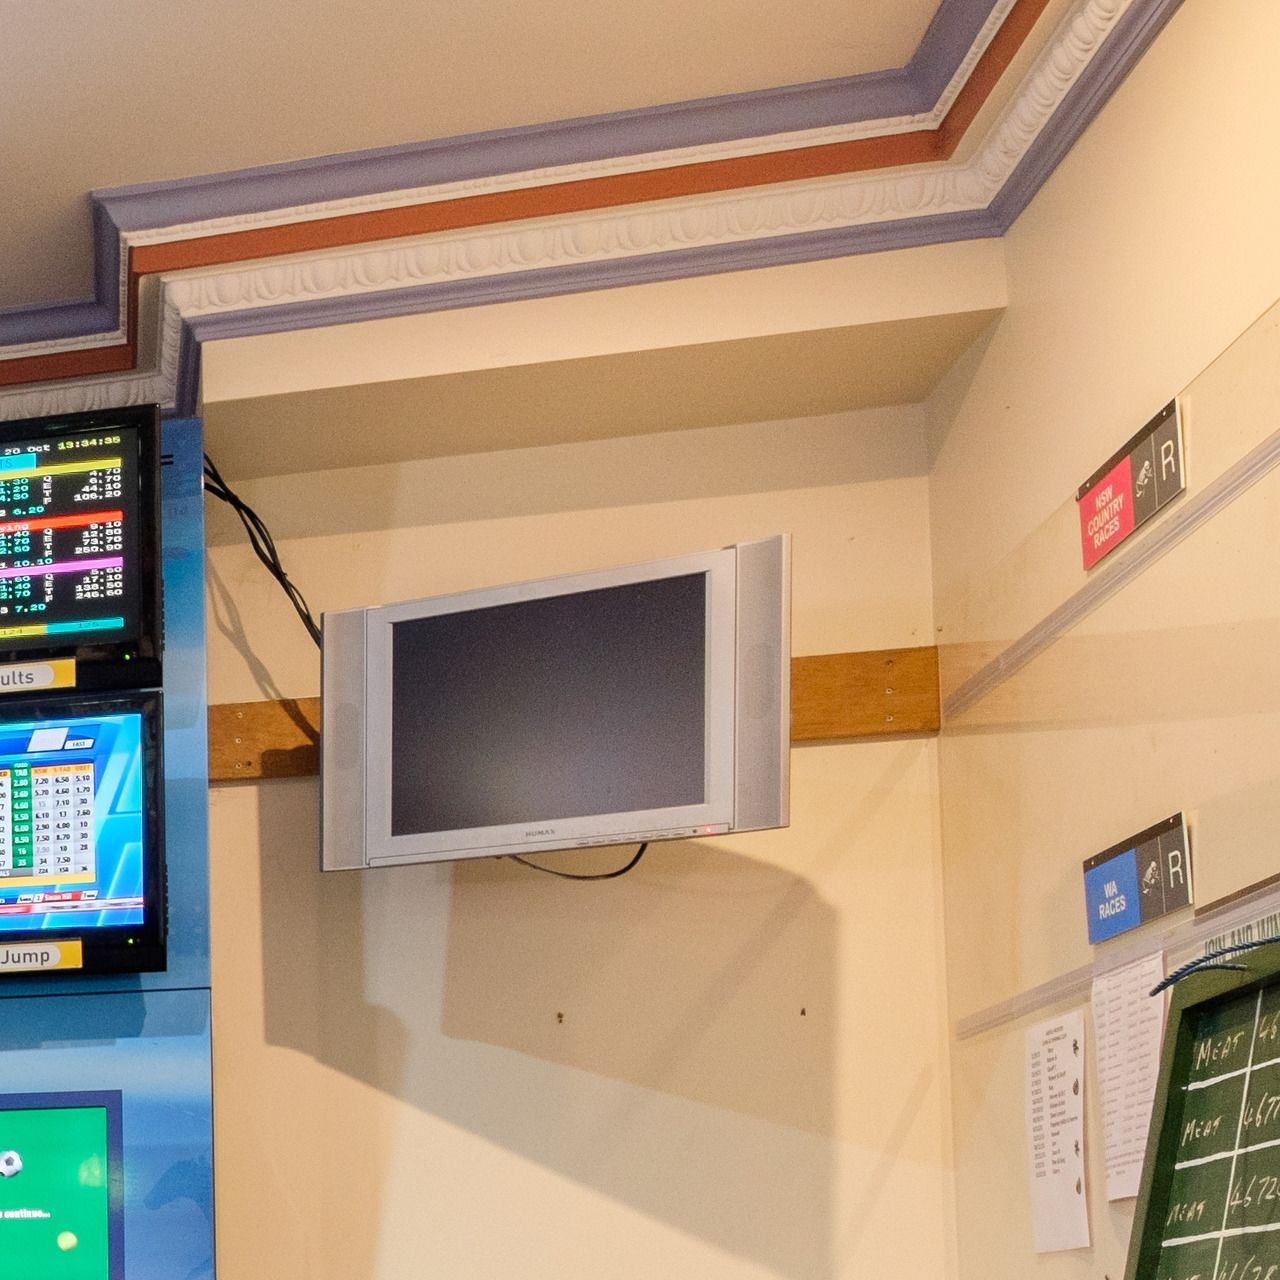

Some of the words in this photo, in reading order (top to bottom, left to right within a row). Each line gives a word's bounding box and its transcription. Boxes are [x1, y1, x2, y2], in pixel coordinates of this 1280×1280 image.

[1161, 440, 1175, 480] R
[1096, 484, 1112, 511] NSW
[1088, 493, 1124, 536] COUNTRY
[1093, 517, 1120, 548] RACES
[1168, 850, 1183, 888] R
[1103, 880, 1118, 898] WA
[1098, 895, 1126, 920] RACES
[1, 948, 50, 966] Jump
[1205, 934, 1225, 965] JOIN
[1231, 924, 1252, 957] AND
